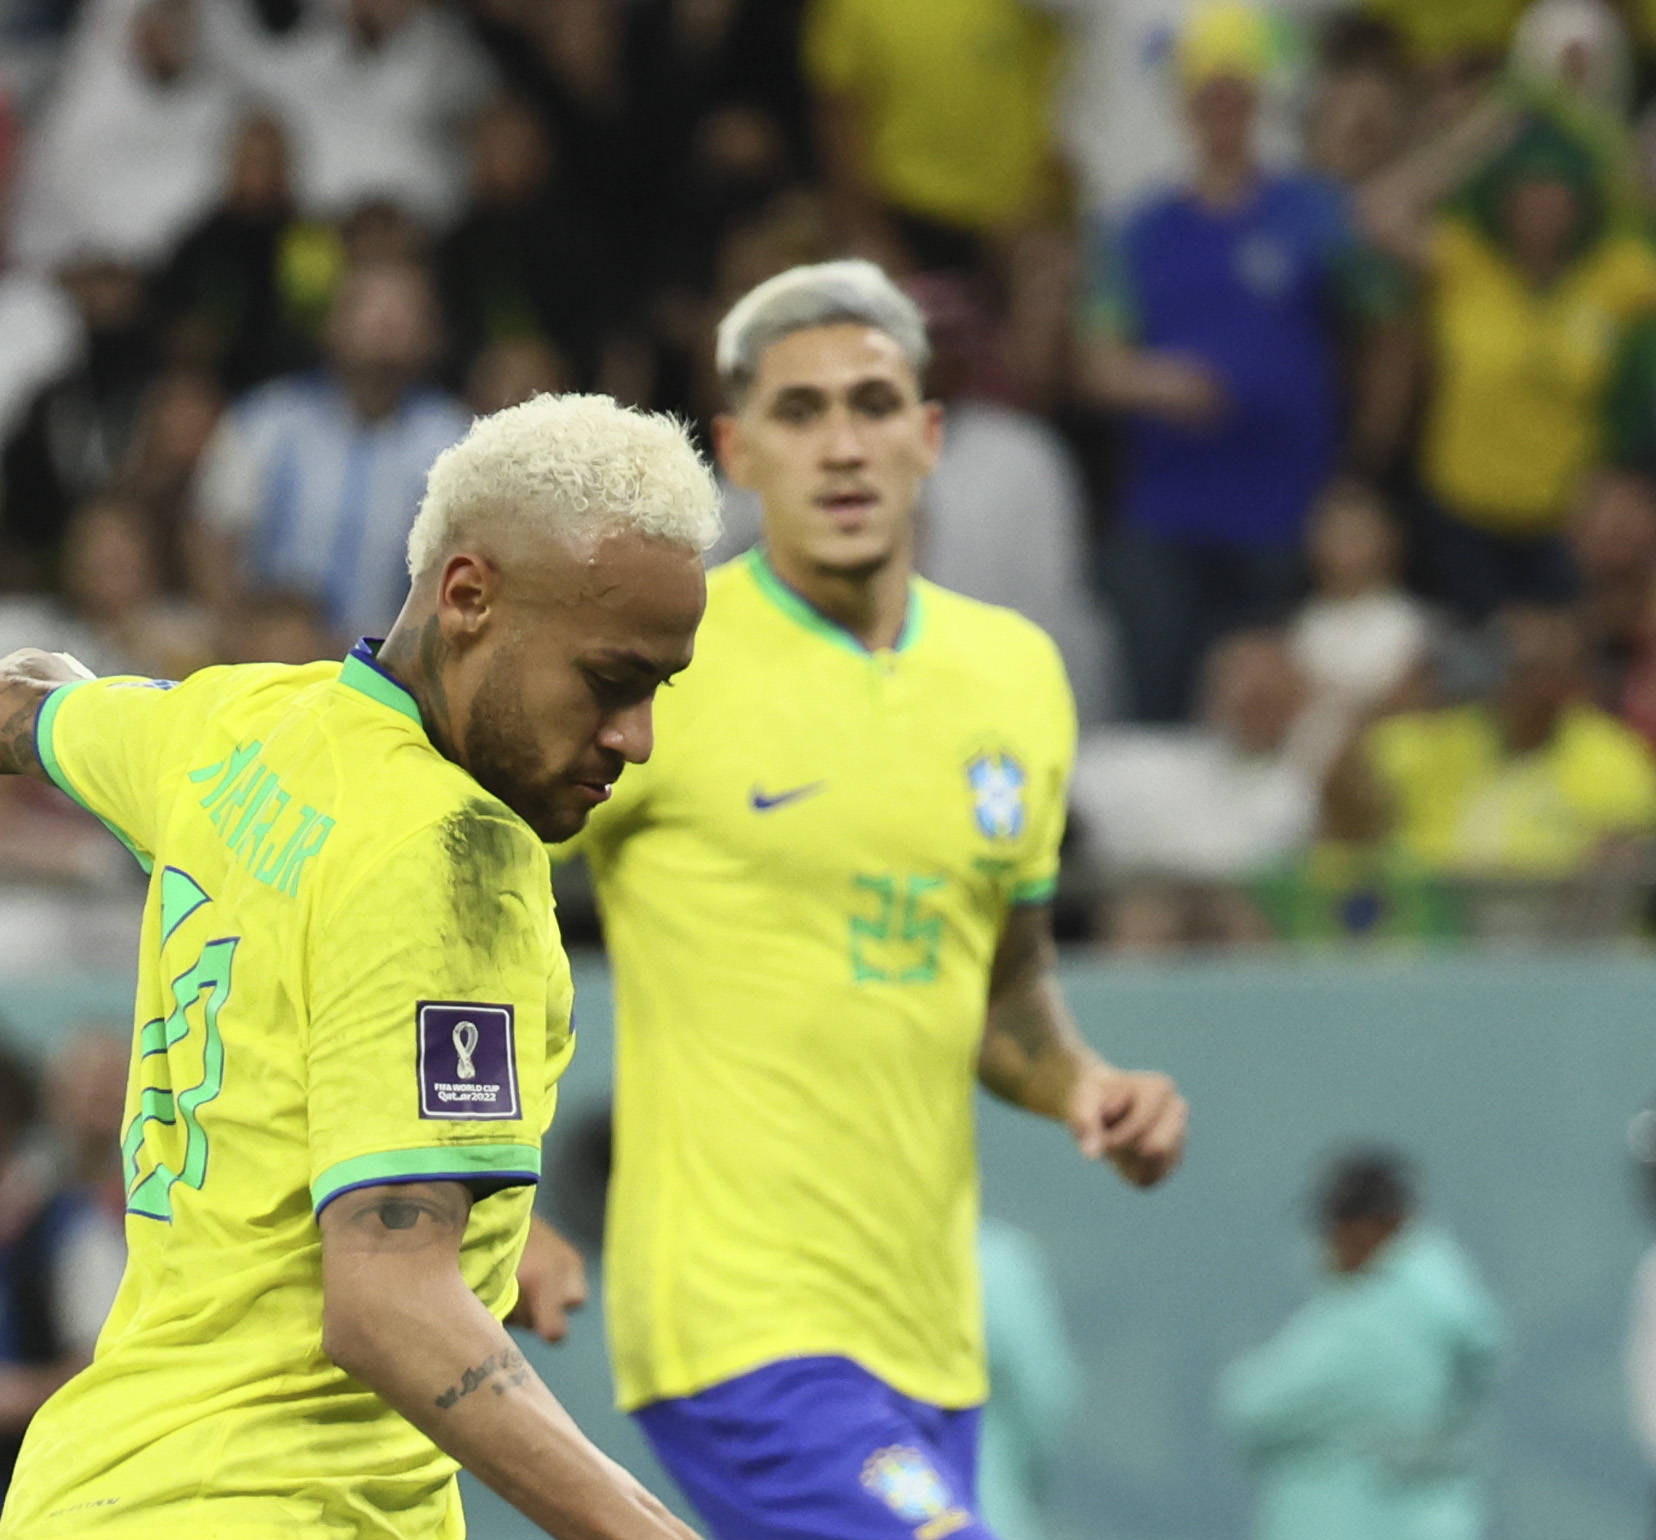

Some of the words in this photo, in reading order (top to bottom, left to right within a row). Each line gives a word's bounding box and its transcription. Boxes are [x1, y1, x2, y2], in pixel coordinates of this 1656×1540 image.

[850, 872, 947, 983] 25
[434, 1083, 452, 1091] FIFA
[452, 1083, 483, 1092] WORLD
[483, 1084, 501, 1093] CUP
